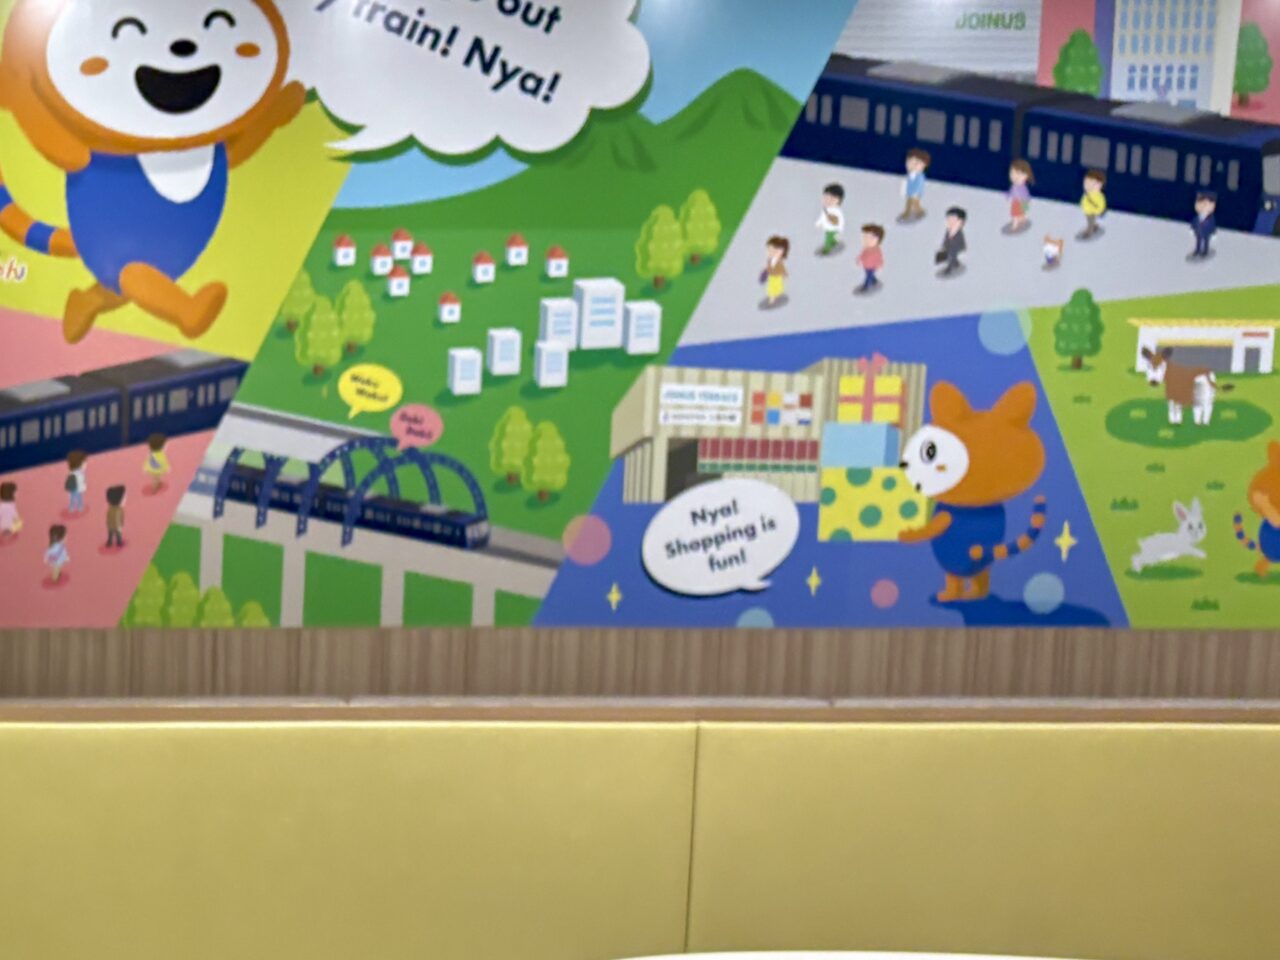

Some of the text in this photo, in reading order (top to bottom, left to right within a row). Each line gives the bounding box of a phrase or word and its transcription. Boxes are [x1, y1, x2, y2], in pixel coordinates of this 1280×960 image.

[496, 0, 562, 34] out
[955, 10, 1027, 31] JOINUS
[463, 36, 563, 104] Nya!
[690, 498, 739, 526] Nya!
[664, 513, 777, 559] Shopping is
[708, 548, 747, 573] fun!
